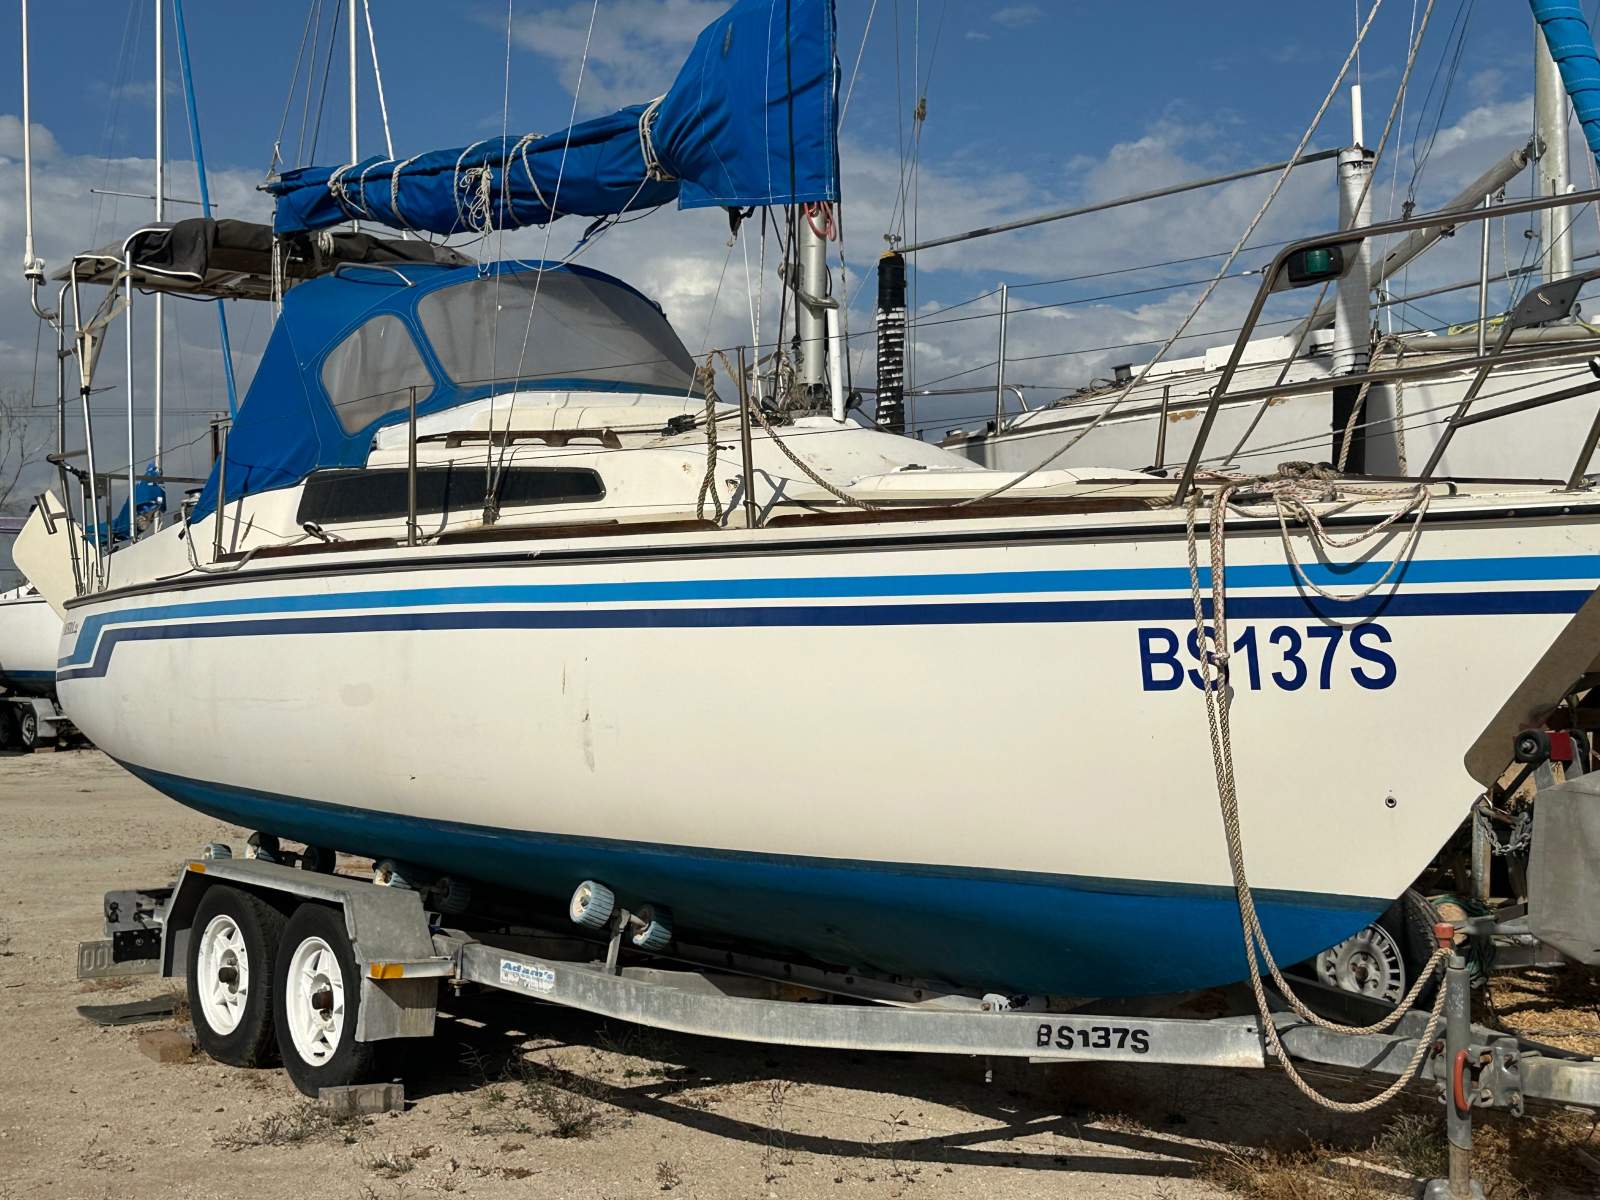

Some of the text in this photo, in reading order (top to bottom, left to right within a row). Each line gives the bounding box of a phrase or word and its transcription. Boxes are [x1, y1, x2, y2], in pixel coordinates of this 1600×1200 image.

[1137, 622, 1397, 692] BS137S
[502, 962, 554, 980] Adam's
[1036, 1023, 1150, 1054] BS137S
